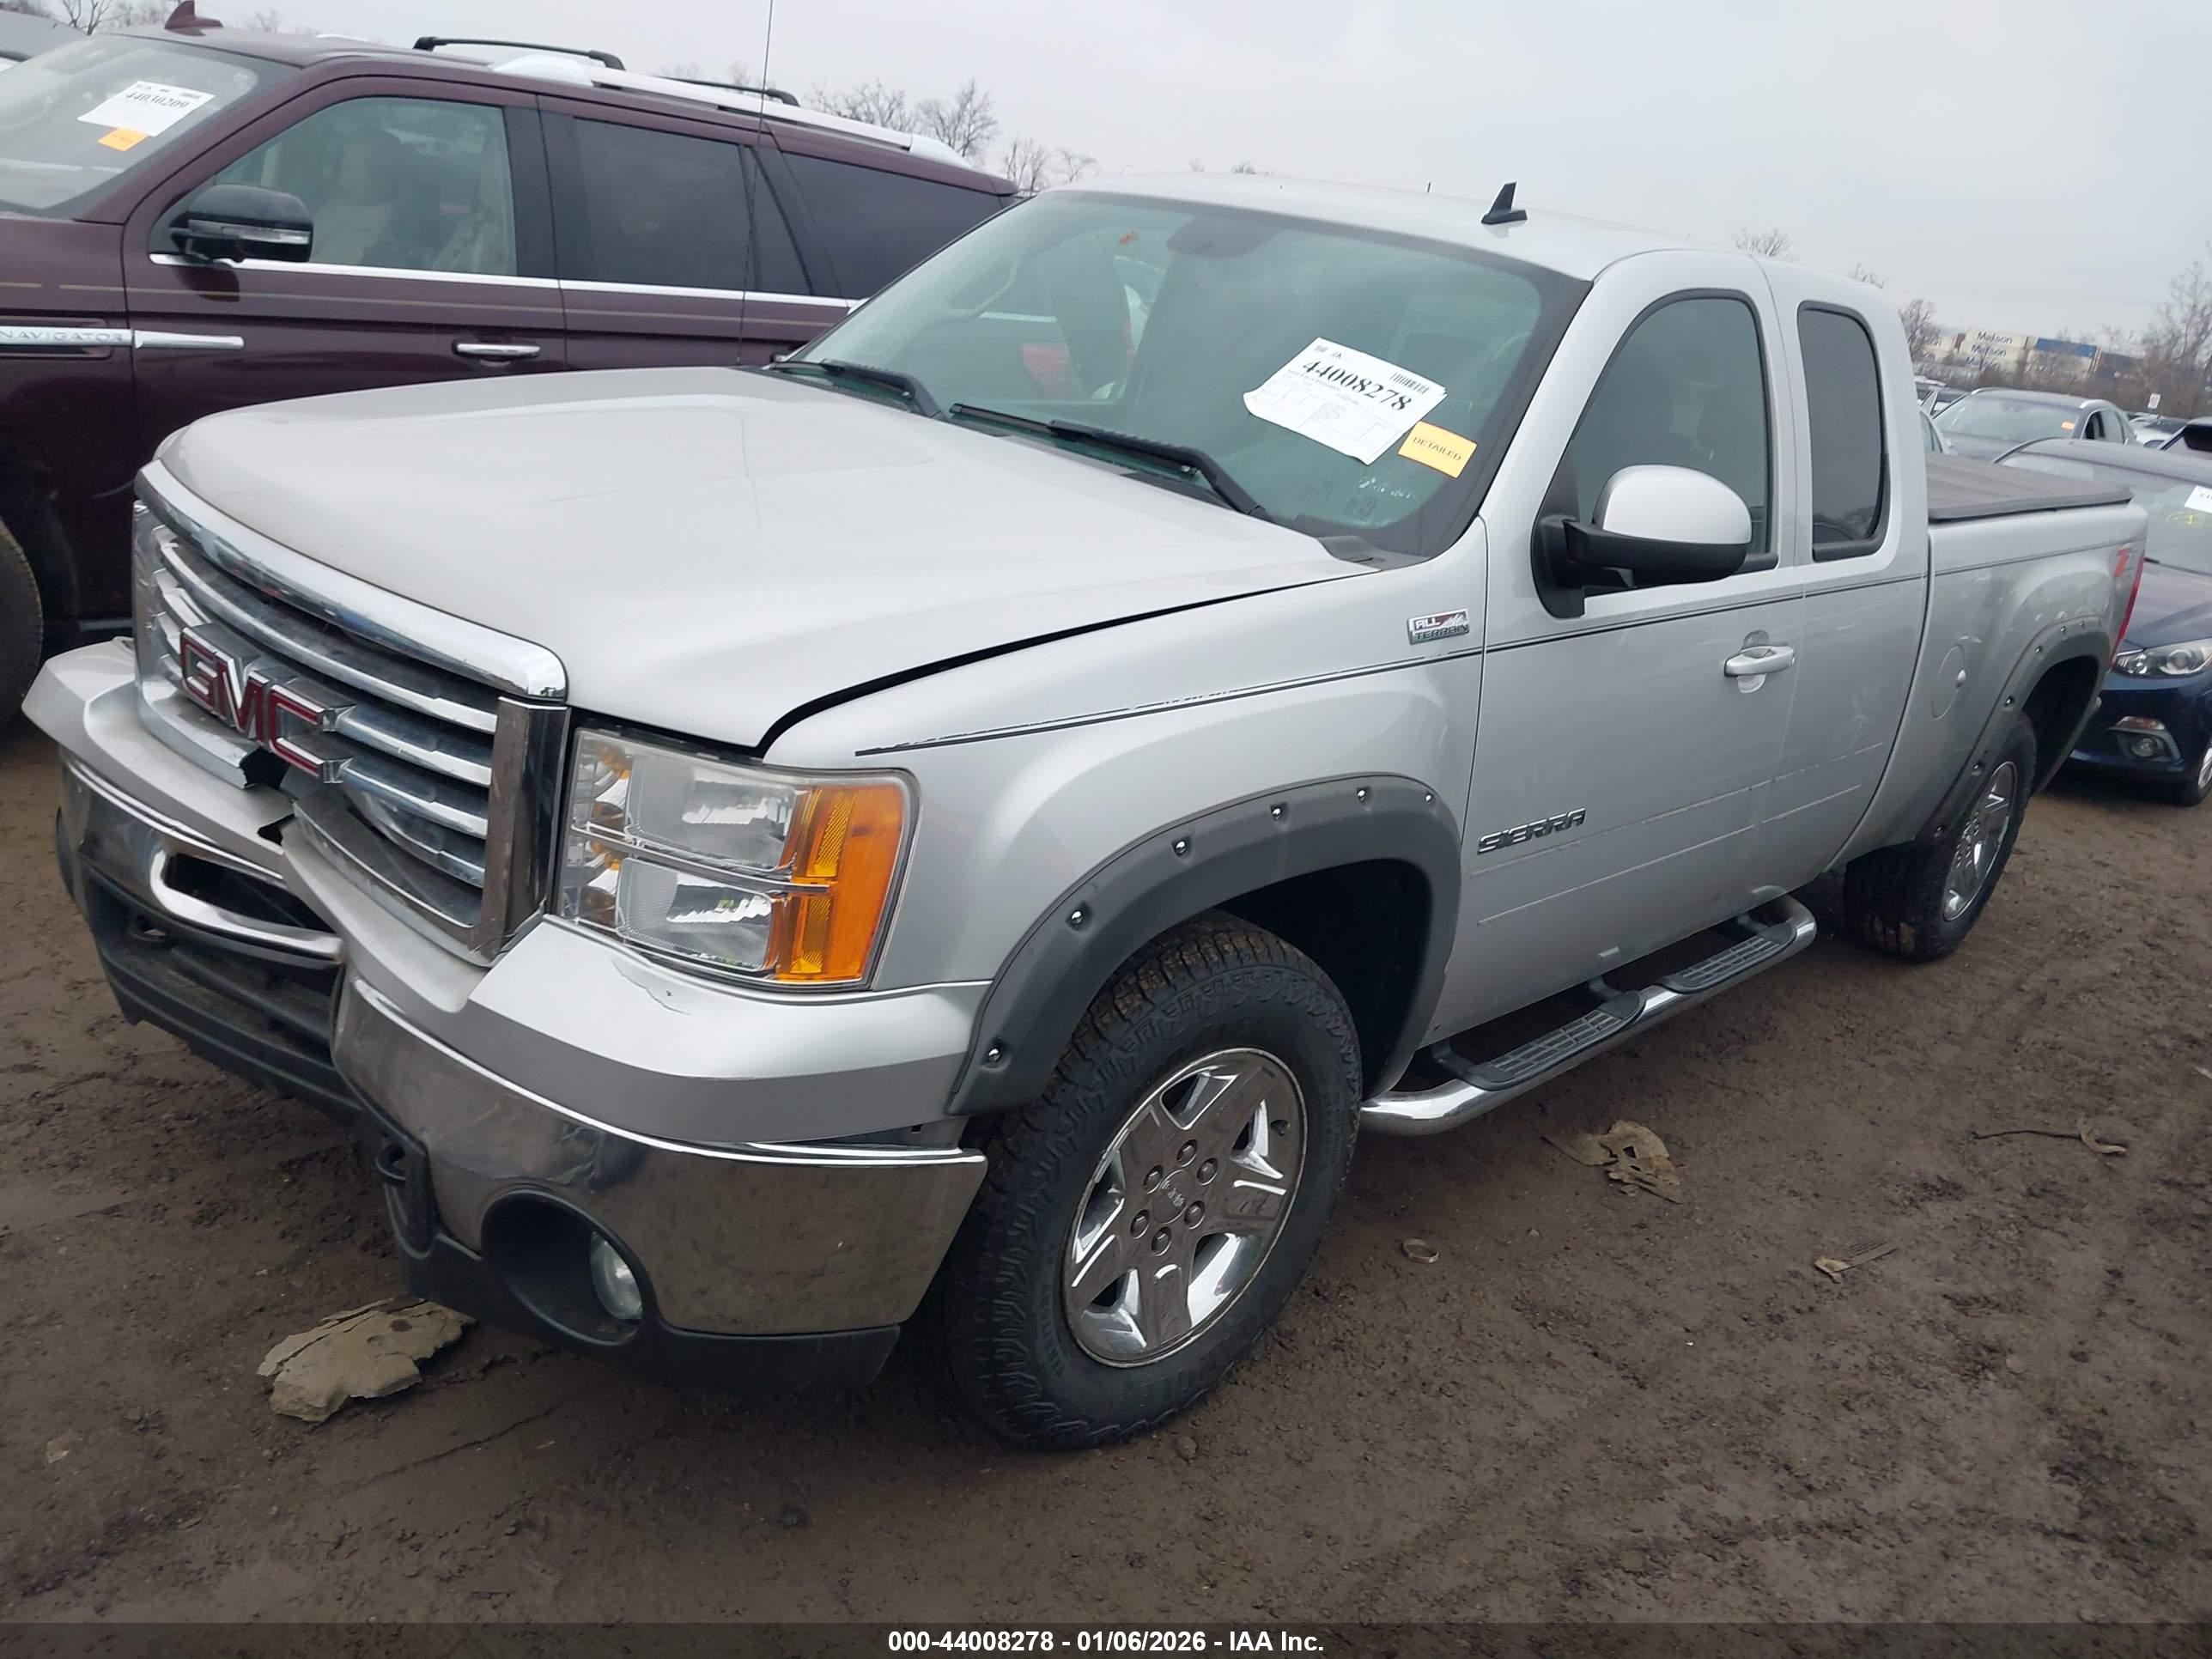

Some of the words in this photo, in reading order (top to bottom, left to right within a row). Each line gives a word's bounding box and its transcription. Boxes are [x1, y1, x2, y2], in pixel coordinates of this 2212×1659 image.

[0, 331, 124, 342] NAVIGATOR
[1302, 360, 1413, 411] 44008278
[1413, 436, 1462, 462] DETAILED
[180, 627, 325, 779] GMC
[1477, 807, 1587, 855] SIERRA
